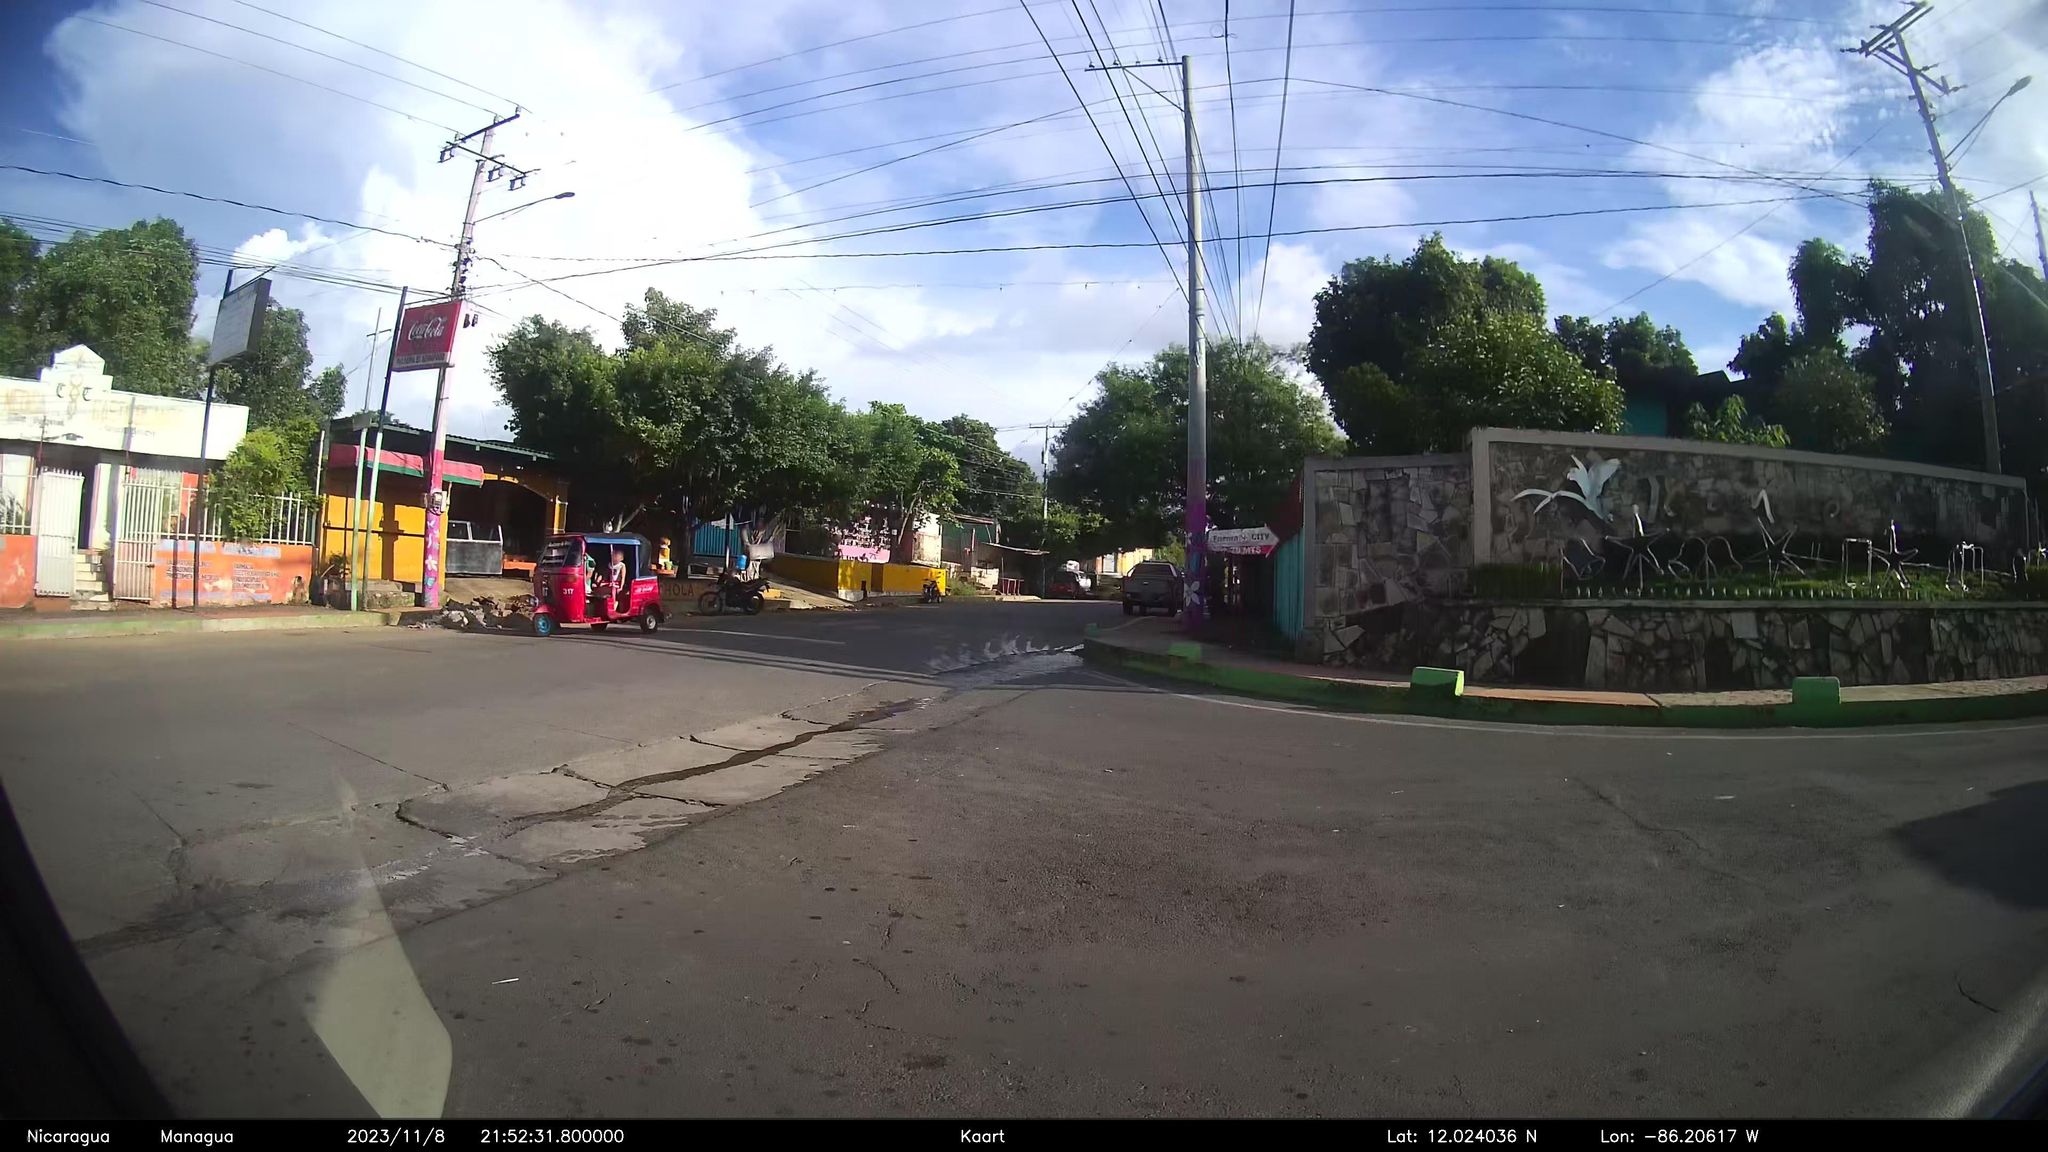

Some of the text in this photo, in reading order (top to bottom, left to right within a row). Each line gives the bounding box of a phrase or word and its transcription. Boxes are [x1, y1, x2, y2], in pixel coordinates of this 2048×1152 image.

[408, 316, 446, 341] Coca-Cola
[1251, 533, 1270, 541] CITY
[1243, 546, 1262, 555] MTS
[562, 587, 575, 595] 317
